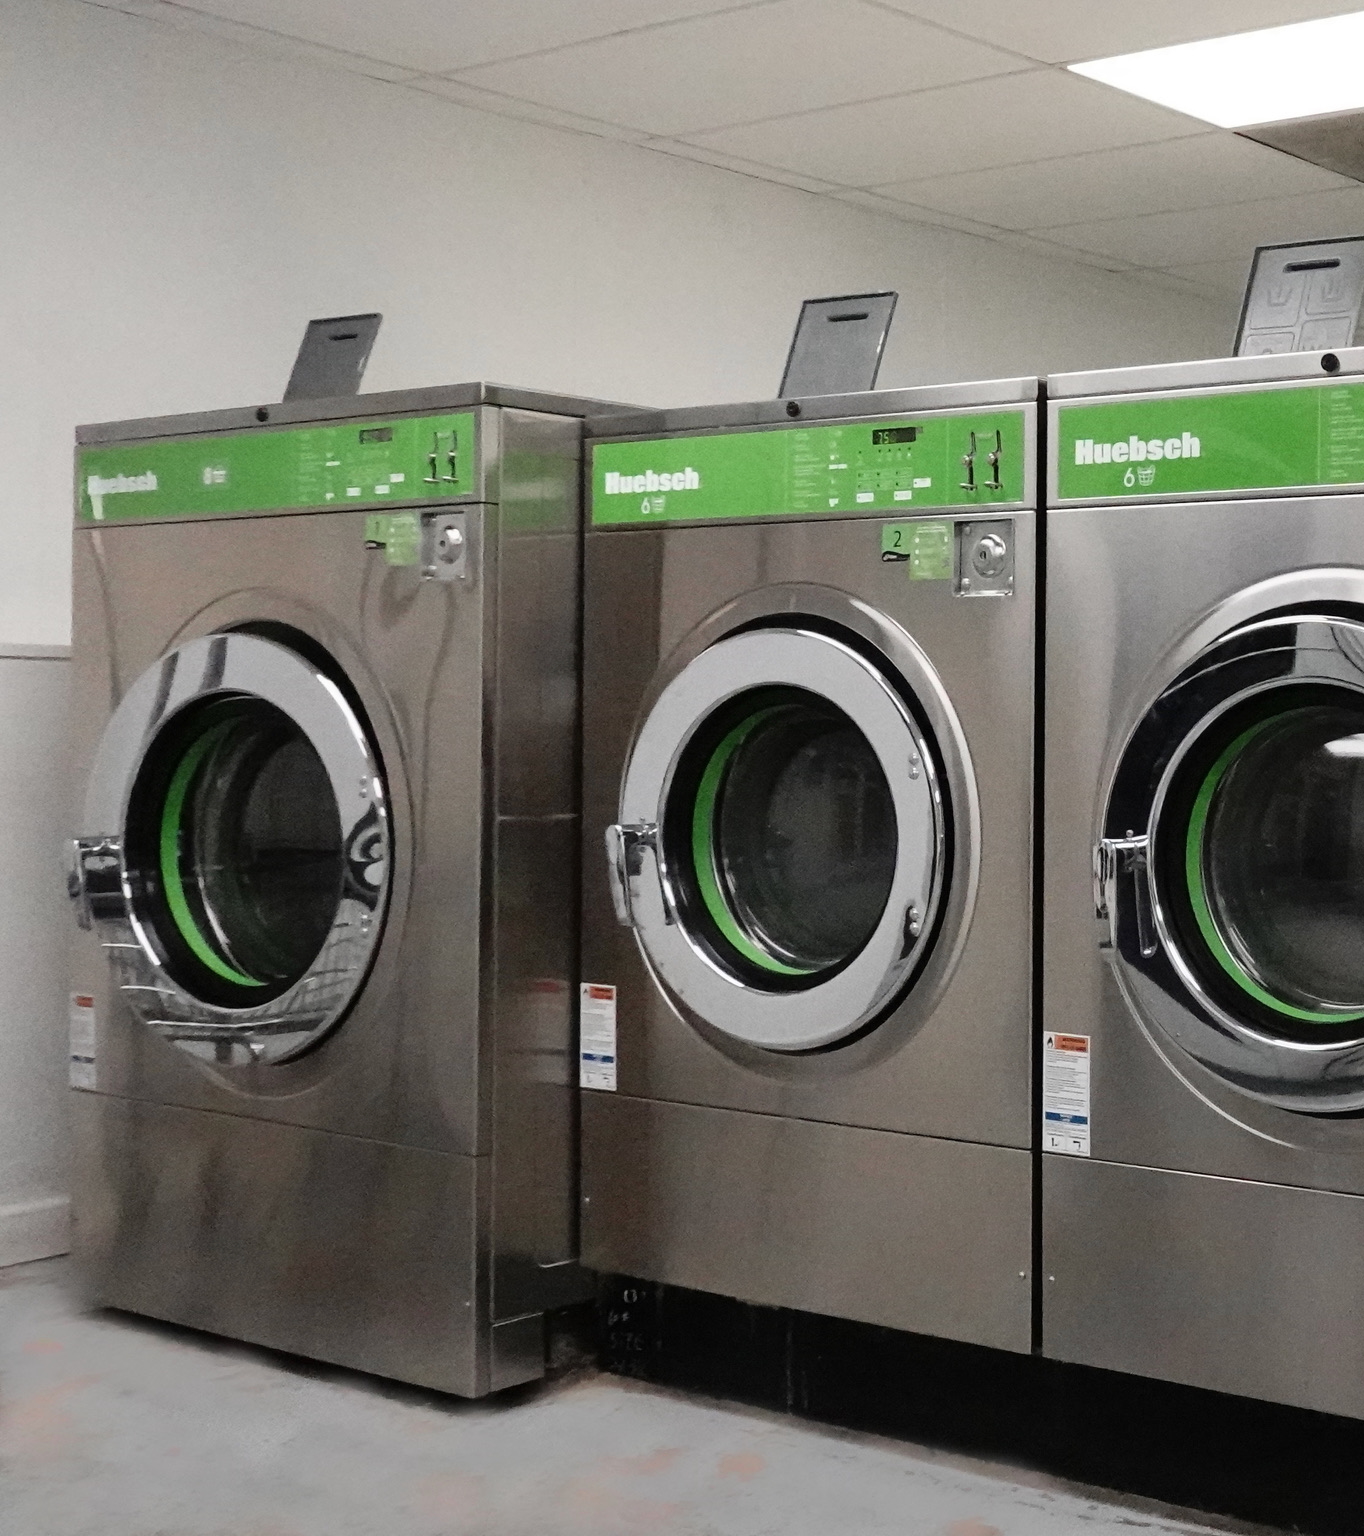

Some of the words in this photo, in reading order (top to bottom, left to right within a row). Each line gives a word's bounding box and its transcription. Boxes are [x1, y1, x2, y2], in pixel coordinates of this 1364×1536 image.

[1075, 431, 1201, 466] Huebsch
[605, 467, 700, 494] Huebsch
[1123, 468, 1136, 488] 6
[640, 497, 651, 514] 6
[893, 530, 902, 548] 2
